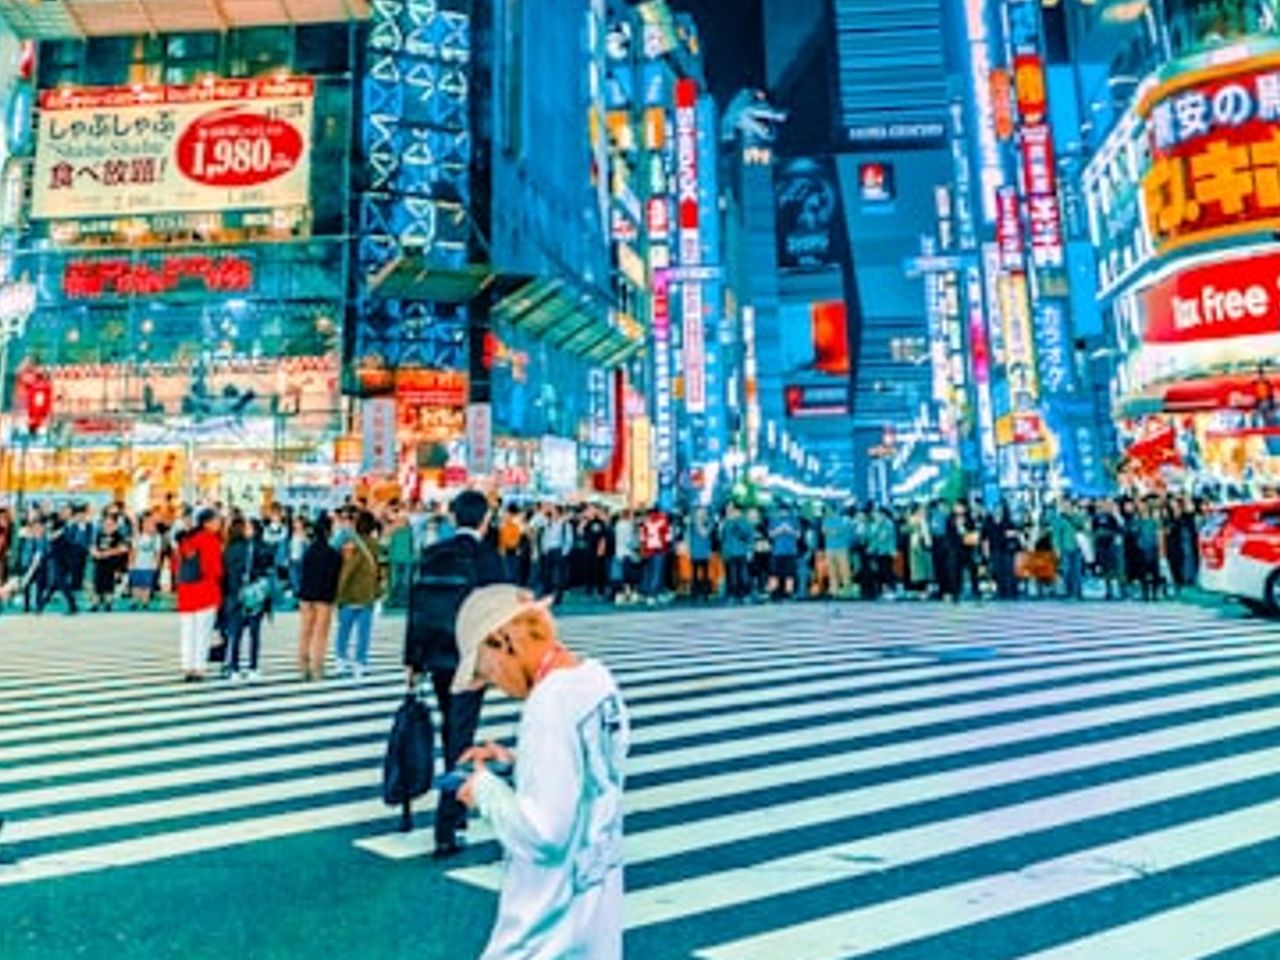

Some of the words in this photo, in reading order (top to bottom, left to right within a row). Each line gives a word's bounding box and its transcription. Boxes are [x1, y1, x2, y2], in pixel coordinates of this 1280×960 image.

[49, 110, 176, 141] しゃぶしゃぶ
[191, 137, 272, 181] 1,980
